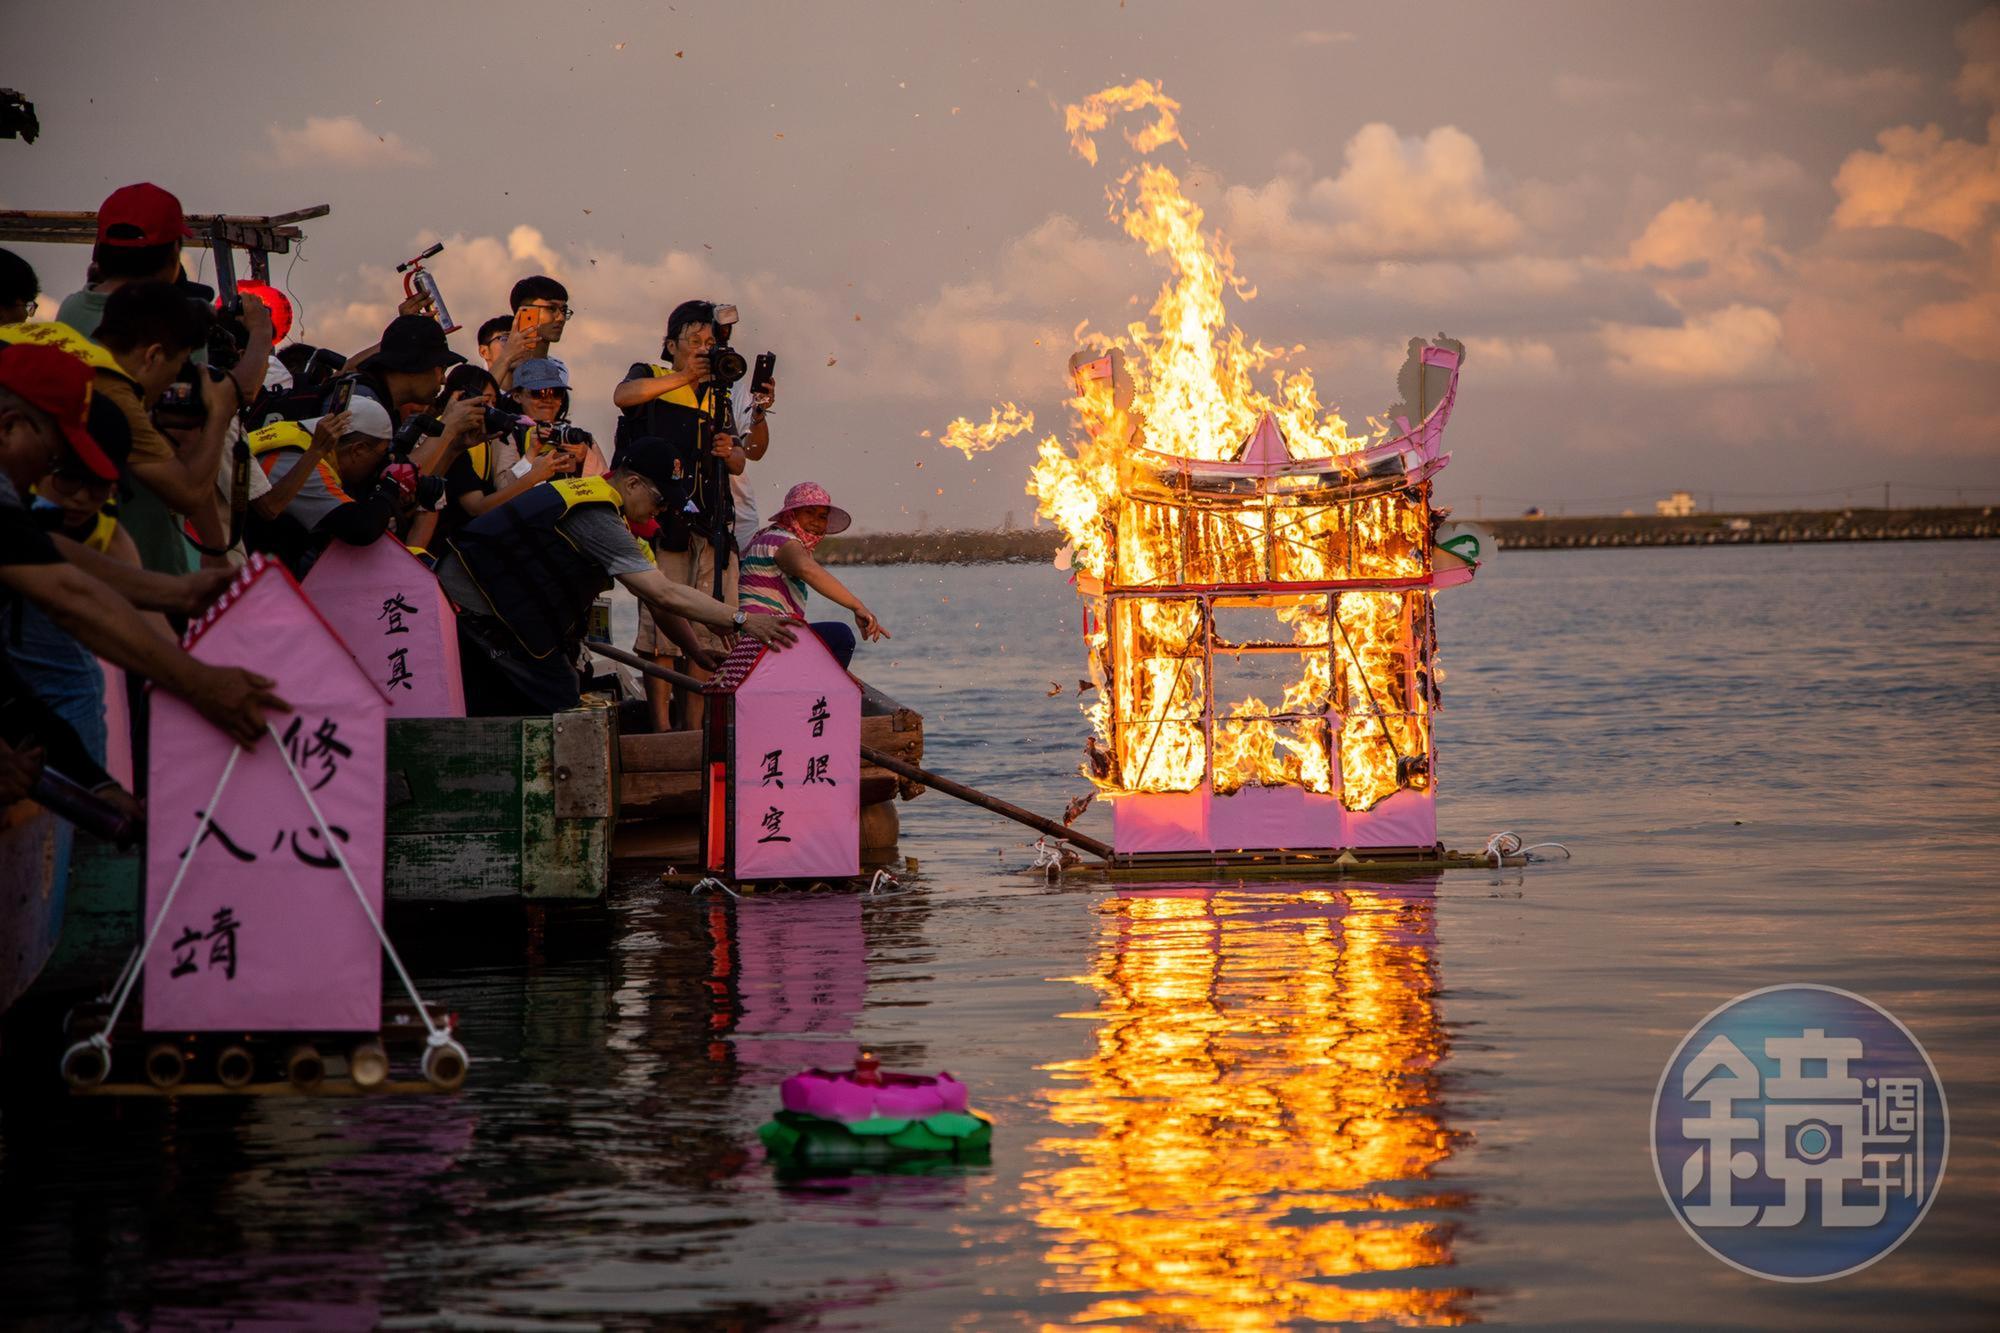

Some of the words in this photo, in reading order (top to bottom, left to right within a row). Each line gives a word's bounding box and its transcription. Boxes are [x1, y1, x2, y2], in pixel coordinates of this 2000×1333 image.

[377, 592, 419, 692] 登真
[270, 715, 353, 869] 修心
[802, 695, 837, 787] 普照
[169, 810, 257, 981] 入靖
